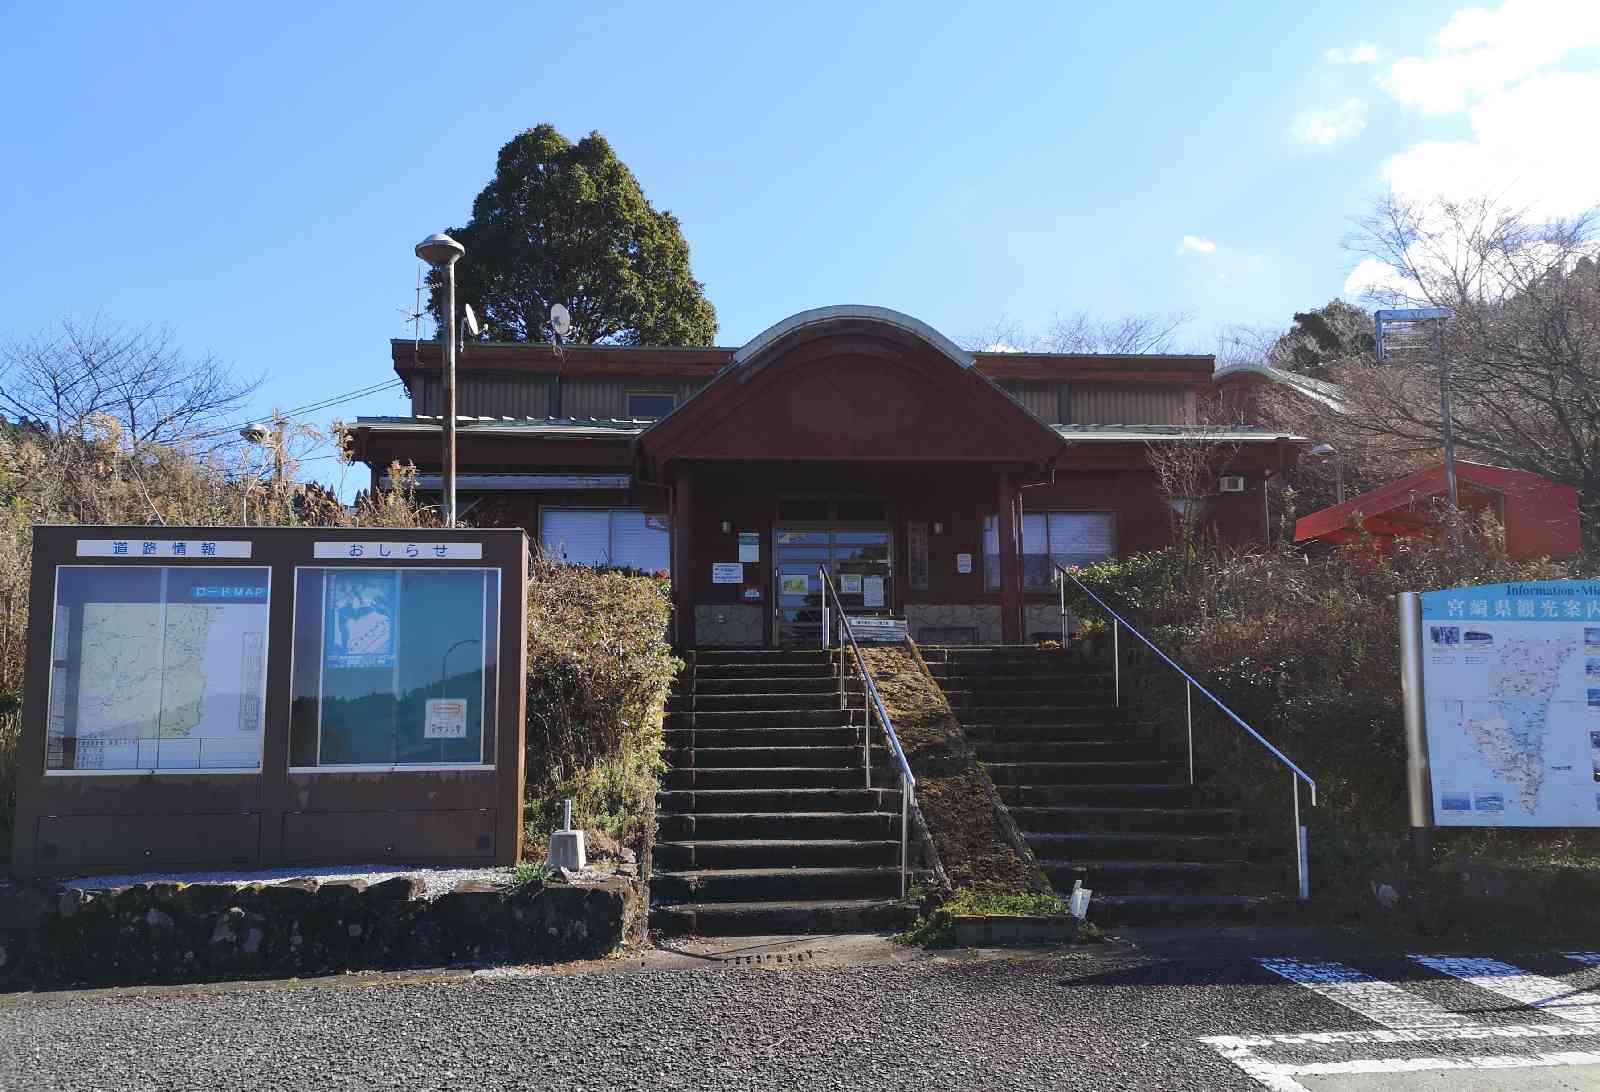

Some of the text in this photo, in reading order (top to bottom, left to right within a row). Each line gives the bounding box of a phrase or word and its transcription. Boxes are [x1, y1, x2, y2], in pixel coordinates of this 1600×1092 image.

[112, 541, 217, 556] 道路情報
[348, 543, 448, 558] おしらせ
